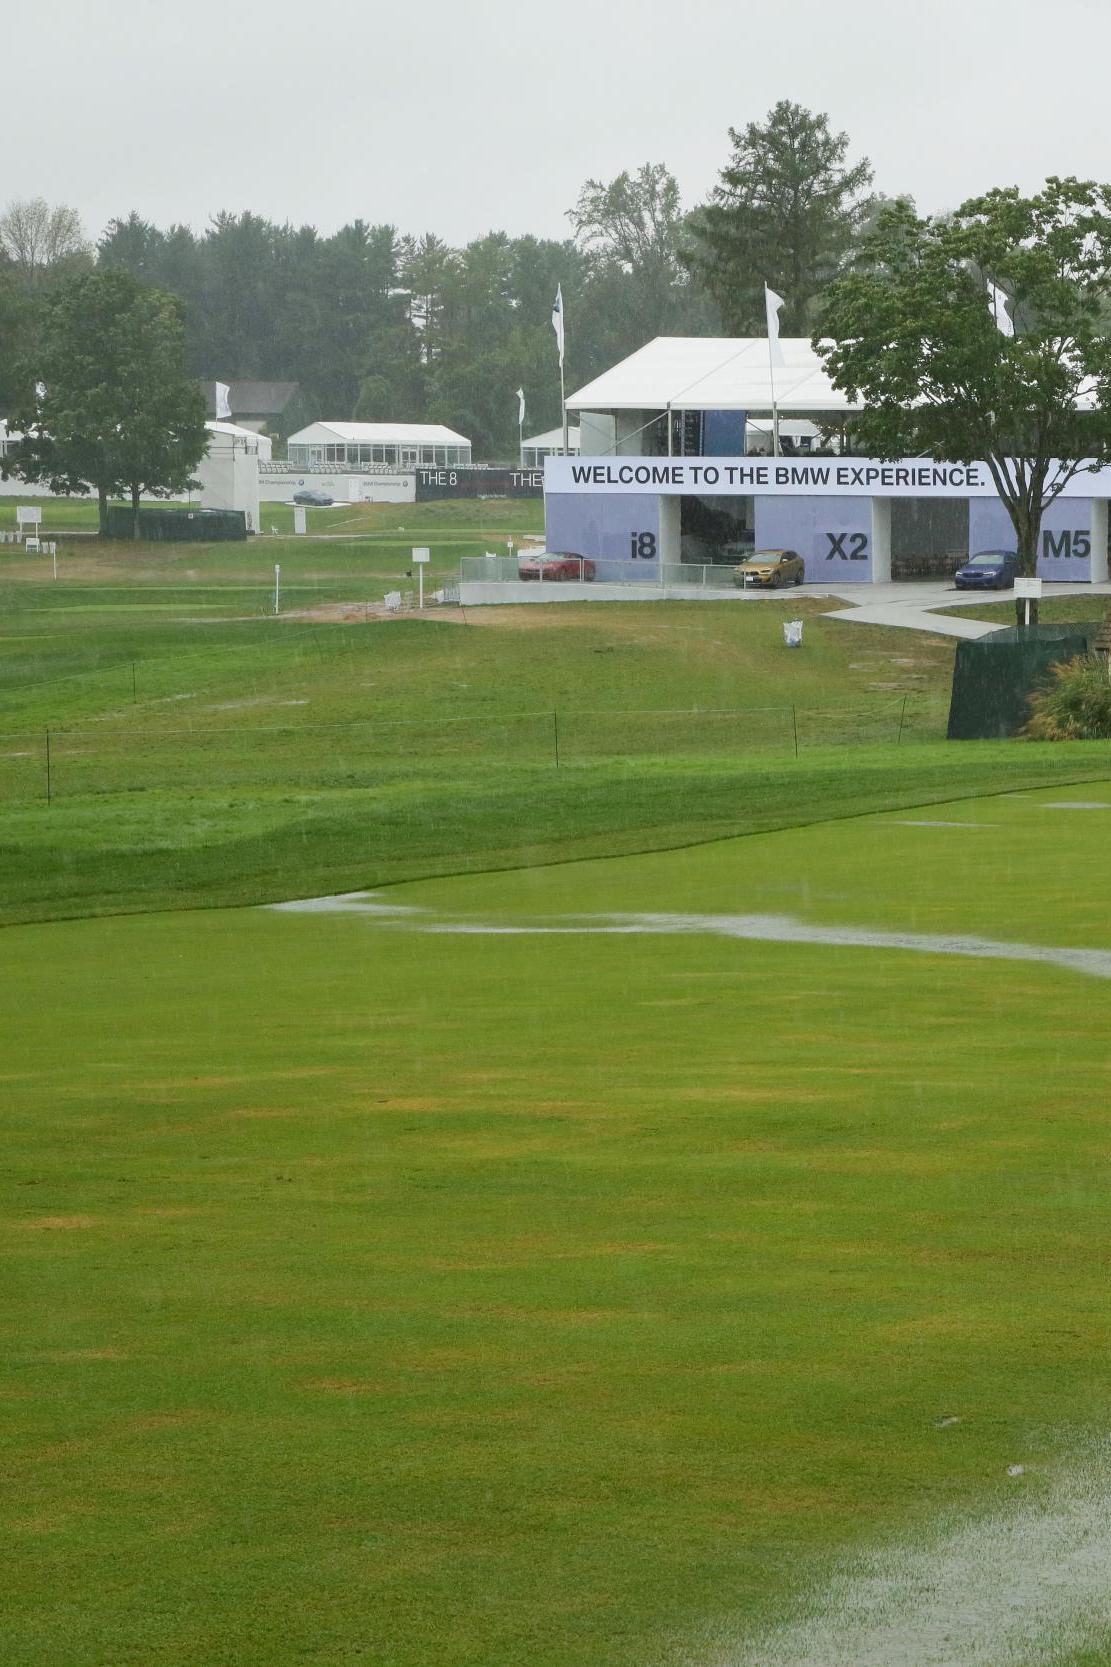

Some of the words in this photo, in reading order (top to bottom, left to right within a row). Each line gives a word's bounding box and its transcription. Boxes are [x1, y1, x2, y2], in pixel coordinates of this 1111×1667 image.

[420, 471, 447, 486] THE
[449, 471, 458, 486] 8
[509, 472, 543, 487] THE
[571, 465, 685, 485] WELCOME
[688, 466, 720, 485] TO
[728, 466, 769, 485] THE
[775, 466, 831, 486] BMW
[836, 466, 986, 487] EXPERIENCE.
[630, 531, 657, 560] i8
[824, 532, 869, 561] X2
[1042, 529, 1092, 559] M5
